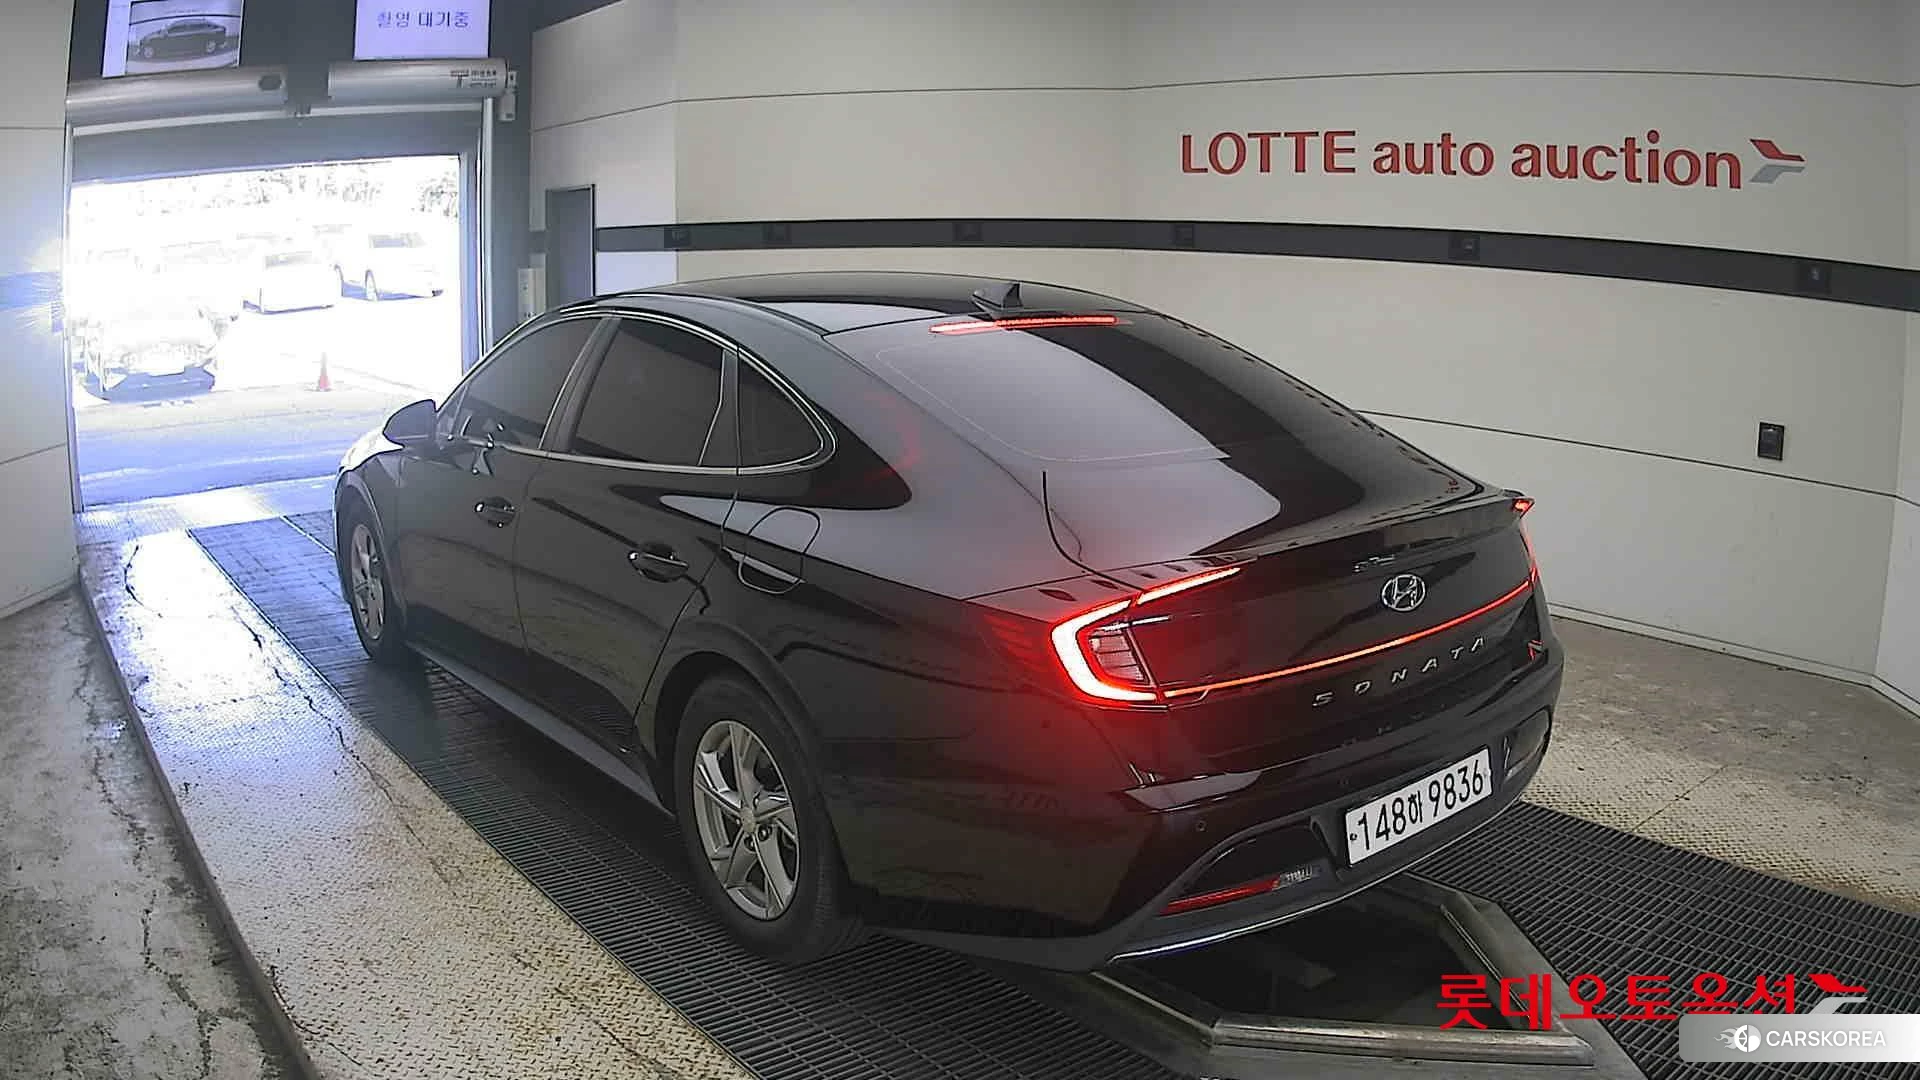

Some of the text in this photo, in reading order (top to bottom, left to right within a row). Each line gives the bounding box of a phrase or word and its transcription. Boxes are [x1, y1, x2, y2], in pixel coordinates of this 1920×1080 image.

[418, 10, 471, 28] 대기중
[1181, 130, 1742, 189] LOTTE auto auction
[1312, 636, 1486, 708] SONATA
